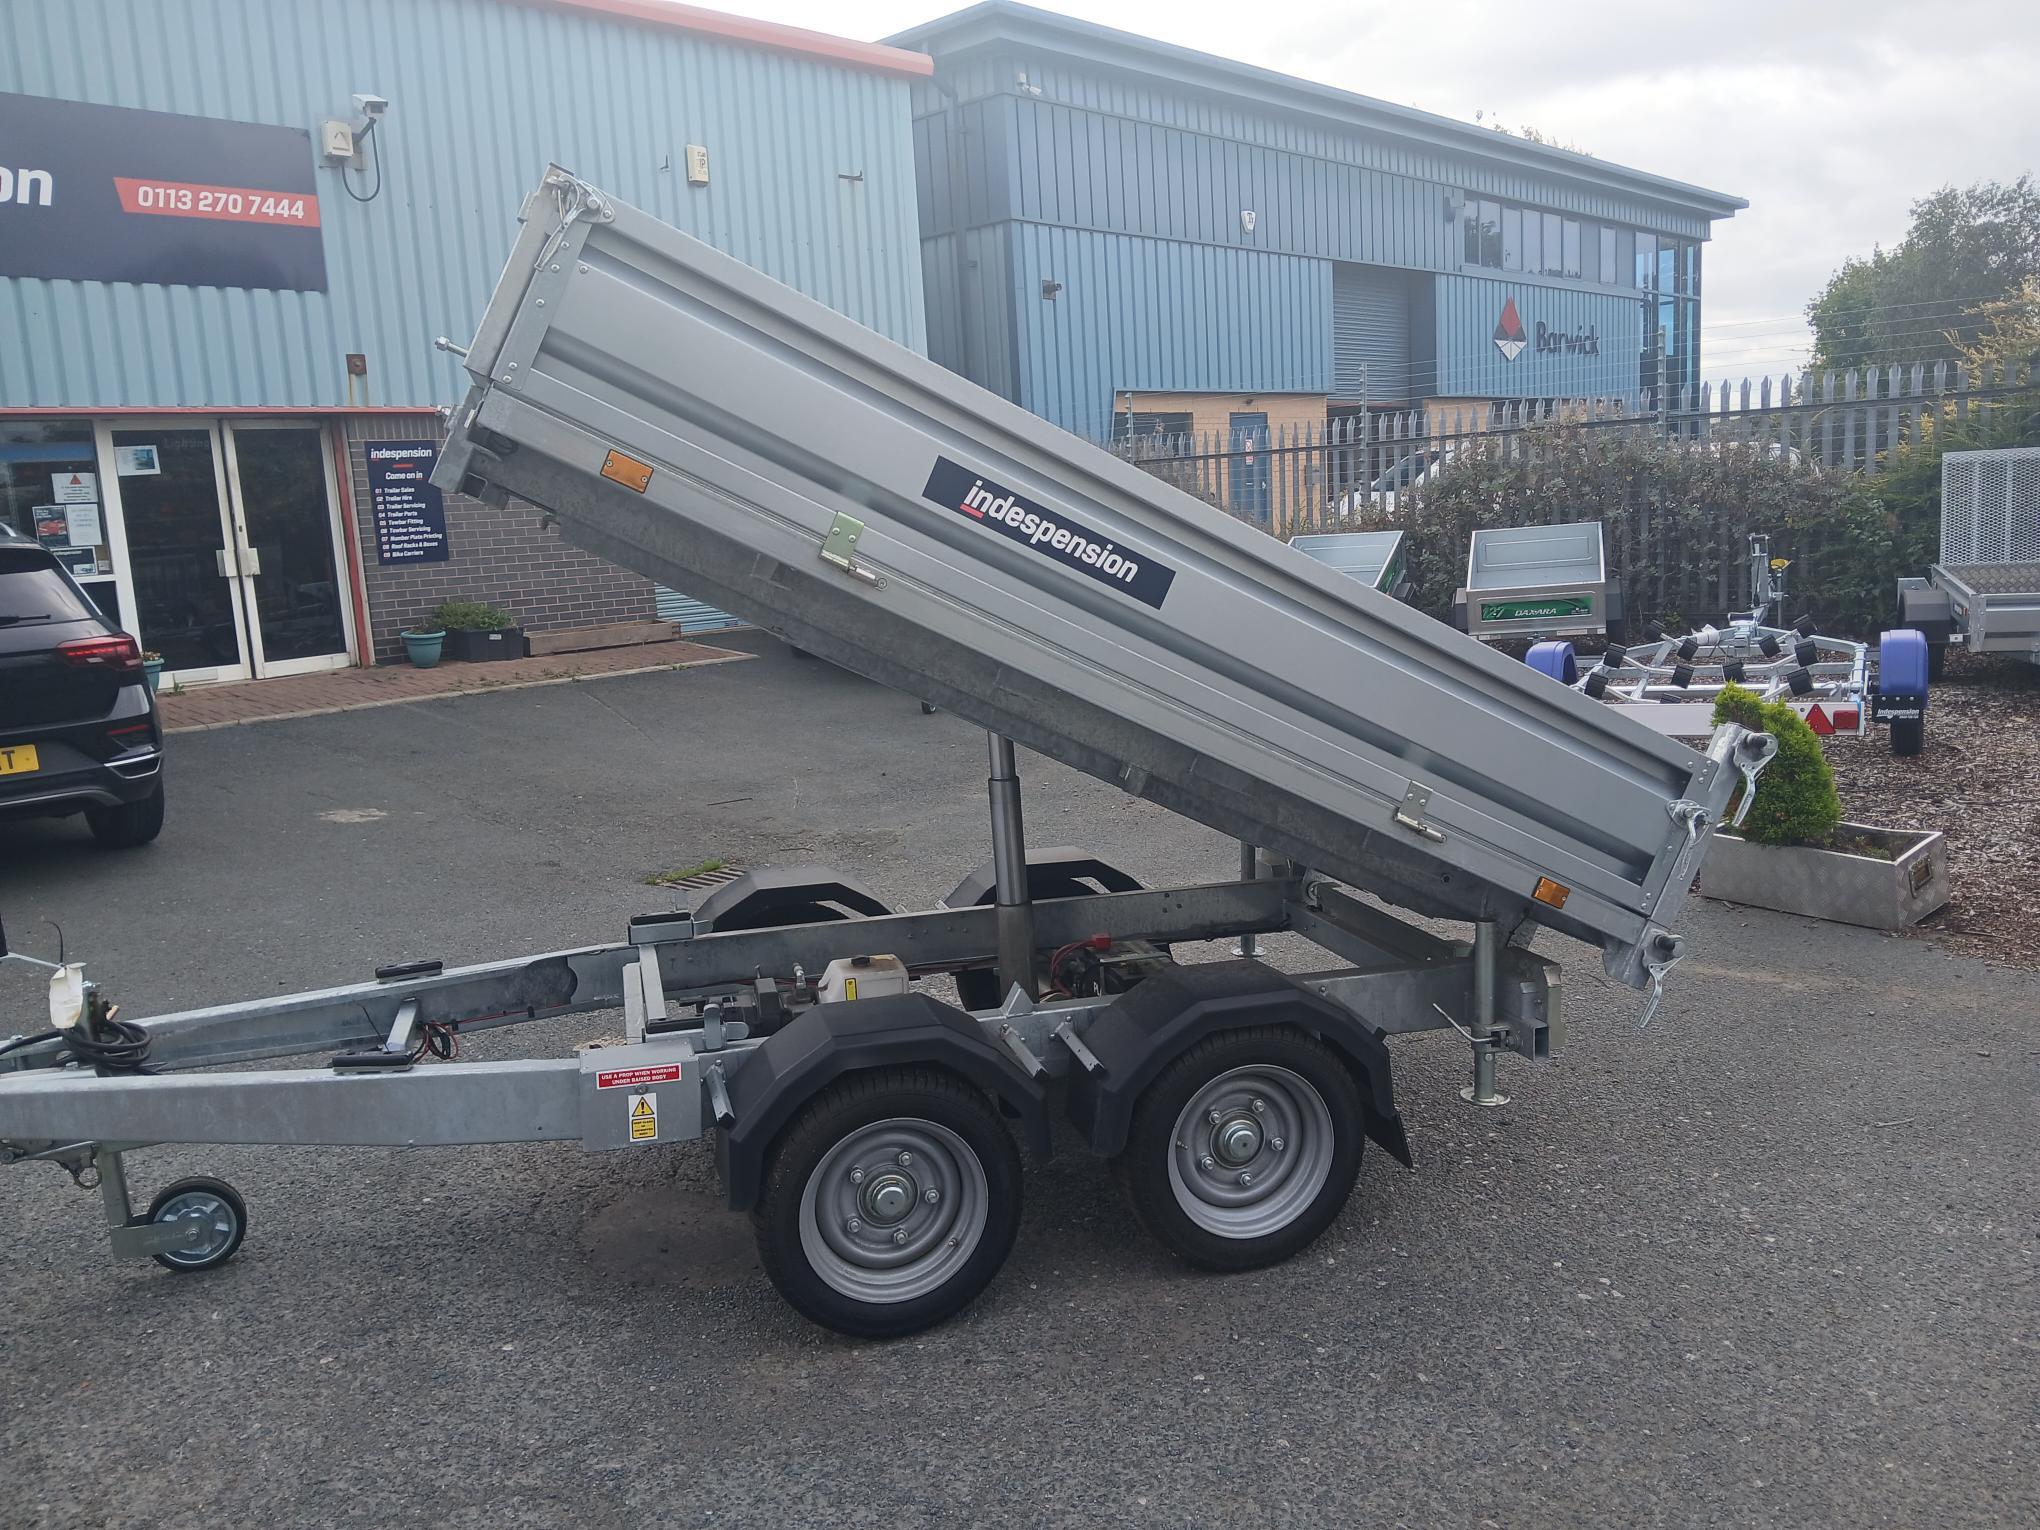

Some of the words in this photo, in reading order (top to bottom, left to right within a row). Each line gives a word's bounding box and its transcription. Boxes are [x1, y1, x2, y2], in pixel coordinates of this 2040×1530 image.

[137, 186, 192, 210] 0113
[198, 191, 242, 214] 270
[248, 195, 304, 219] 7444
[1535, 321, 1601, 356] Barwick
[371, 447, 432, 460] indespension
[963, 479, 1139, 583] indespension
[0, 749, 16, 771] T
